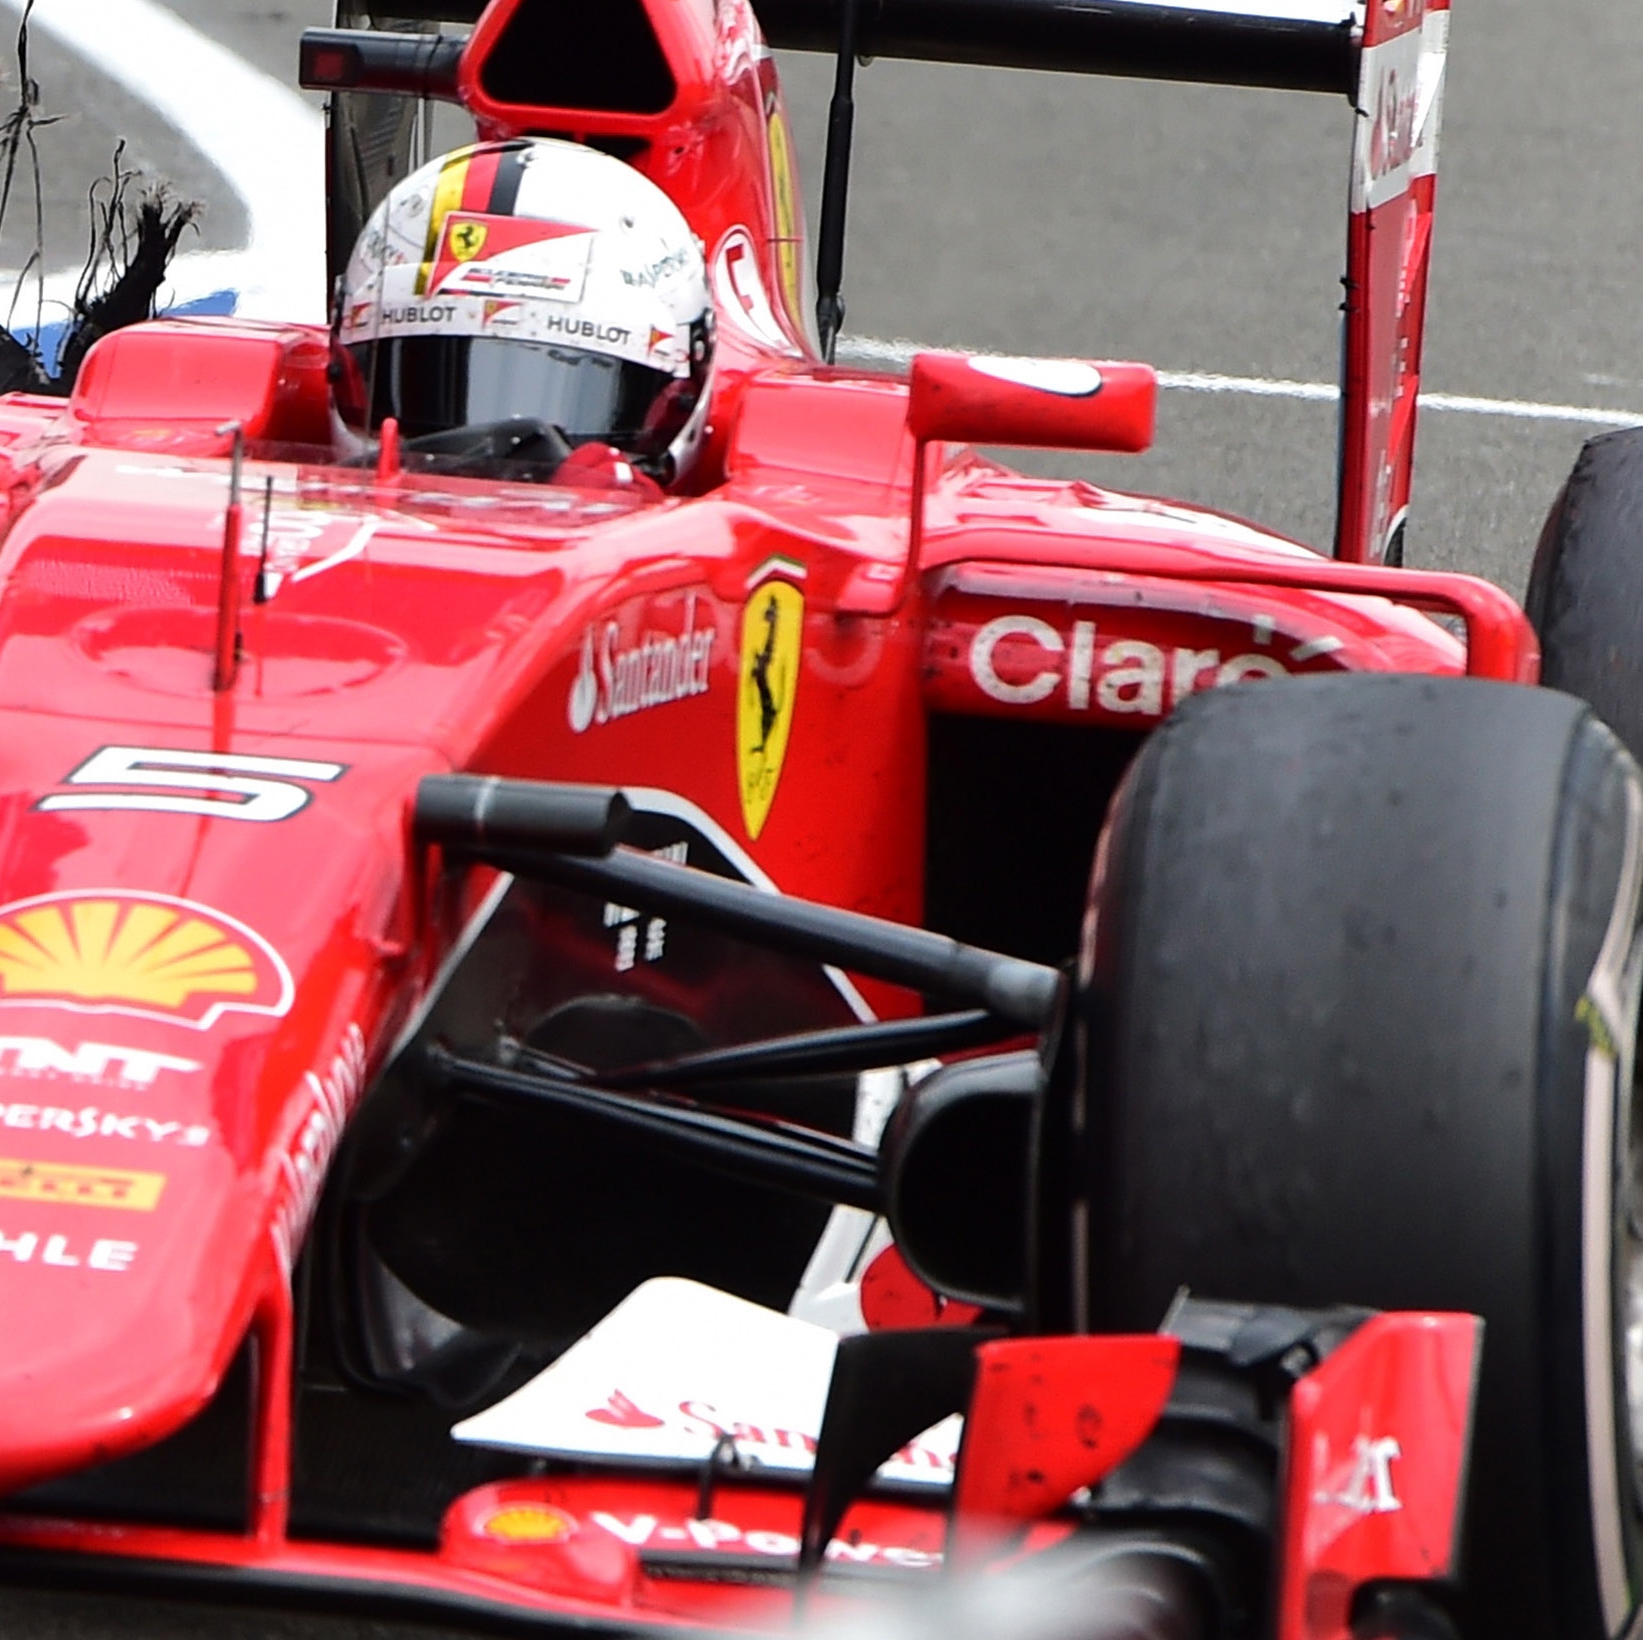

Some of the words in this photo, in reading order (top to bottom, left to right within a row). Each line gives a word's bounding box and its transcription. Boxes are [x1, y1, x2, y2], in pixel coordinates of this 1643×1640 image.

[382, 305, 457, 323] HUBLOT
[547, 314, 632, 346] HUBLOT
[595, 591, 715, 725] Santander
[29, 744, 351, 823] 5
